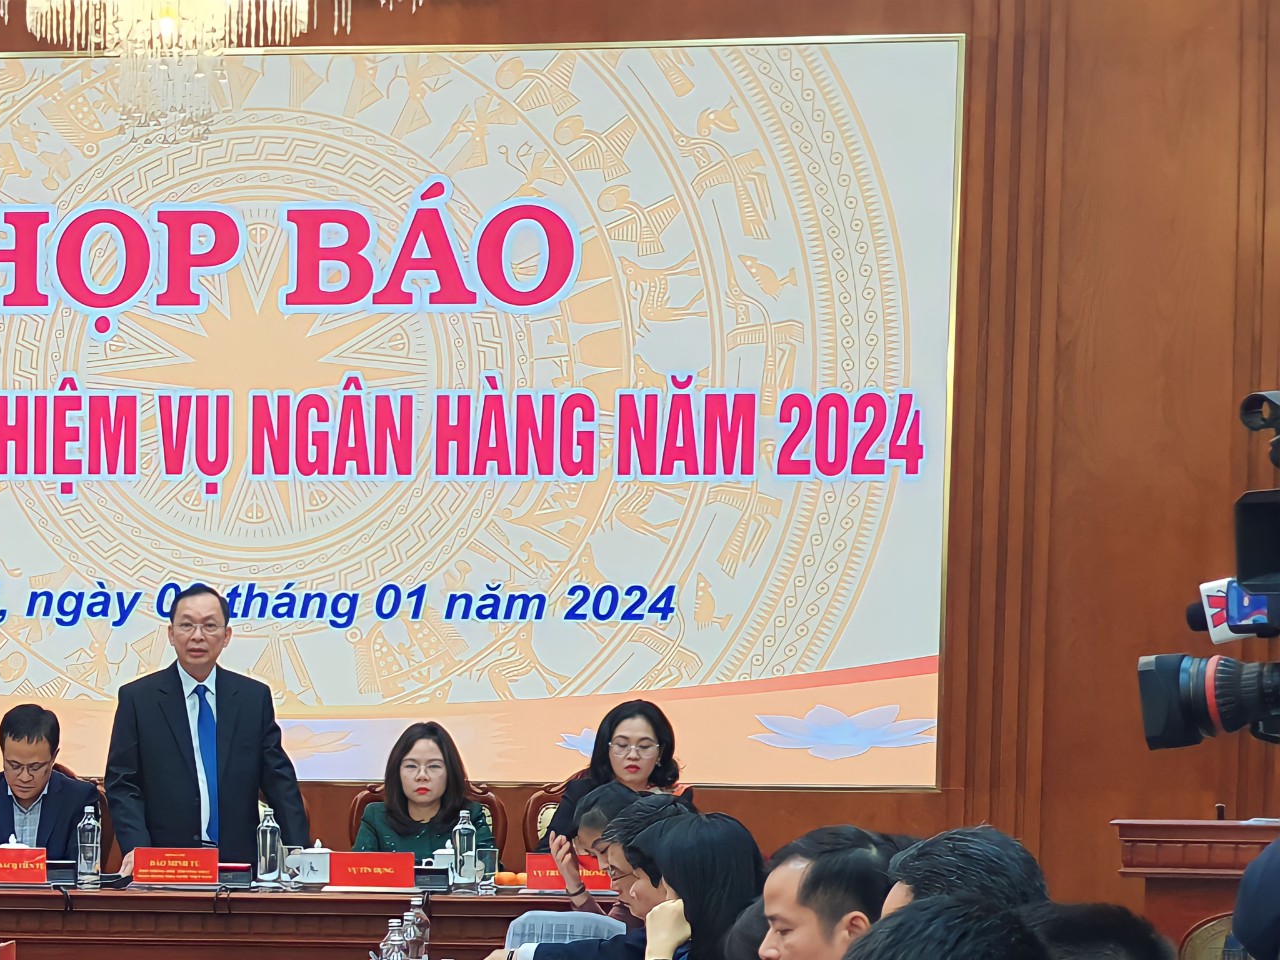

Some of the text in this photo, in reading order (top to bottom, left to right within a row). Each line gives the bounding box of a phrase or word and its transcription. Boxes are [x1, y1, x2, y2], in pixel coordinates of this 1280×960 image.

[285, 182, 576, 307] BÁO
[158, 395, 231, 496] VỤ
[251, 377, 414, 478] NGÂN
[435, 376, 596, 478] HÀNG
[617, 376, 757, 478] NĂM
[777, 392, 926, 478] 2024
[26, 581, 144, 628] ngày
[156, 582, 210, 619] 0
[226, 582, 361, 630] tháng
[375, 583, 429, 621] 01
[444, 583, 549, 621] năm
[563, 584, 678, 622] 2024
